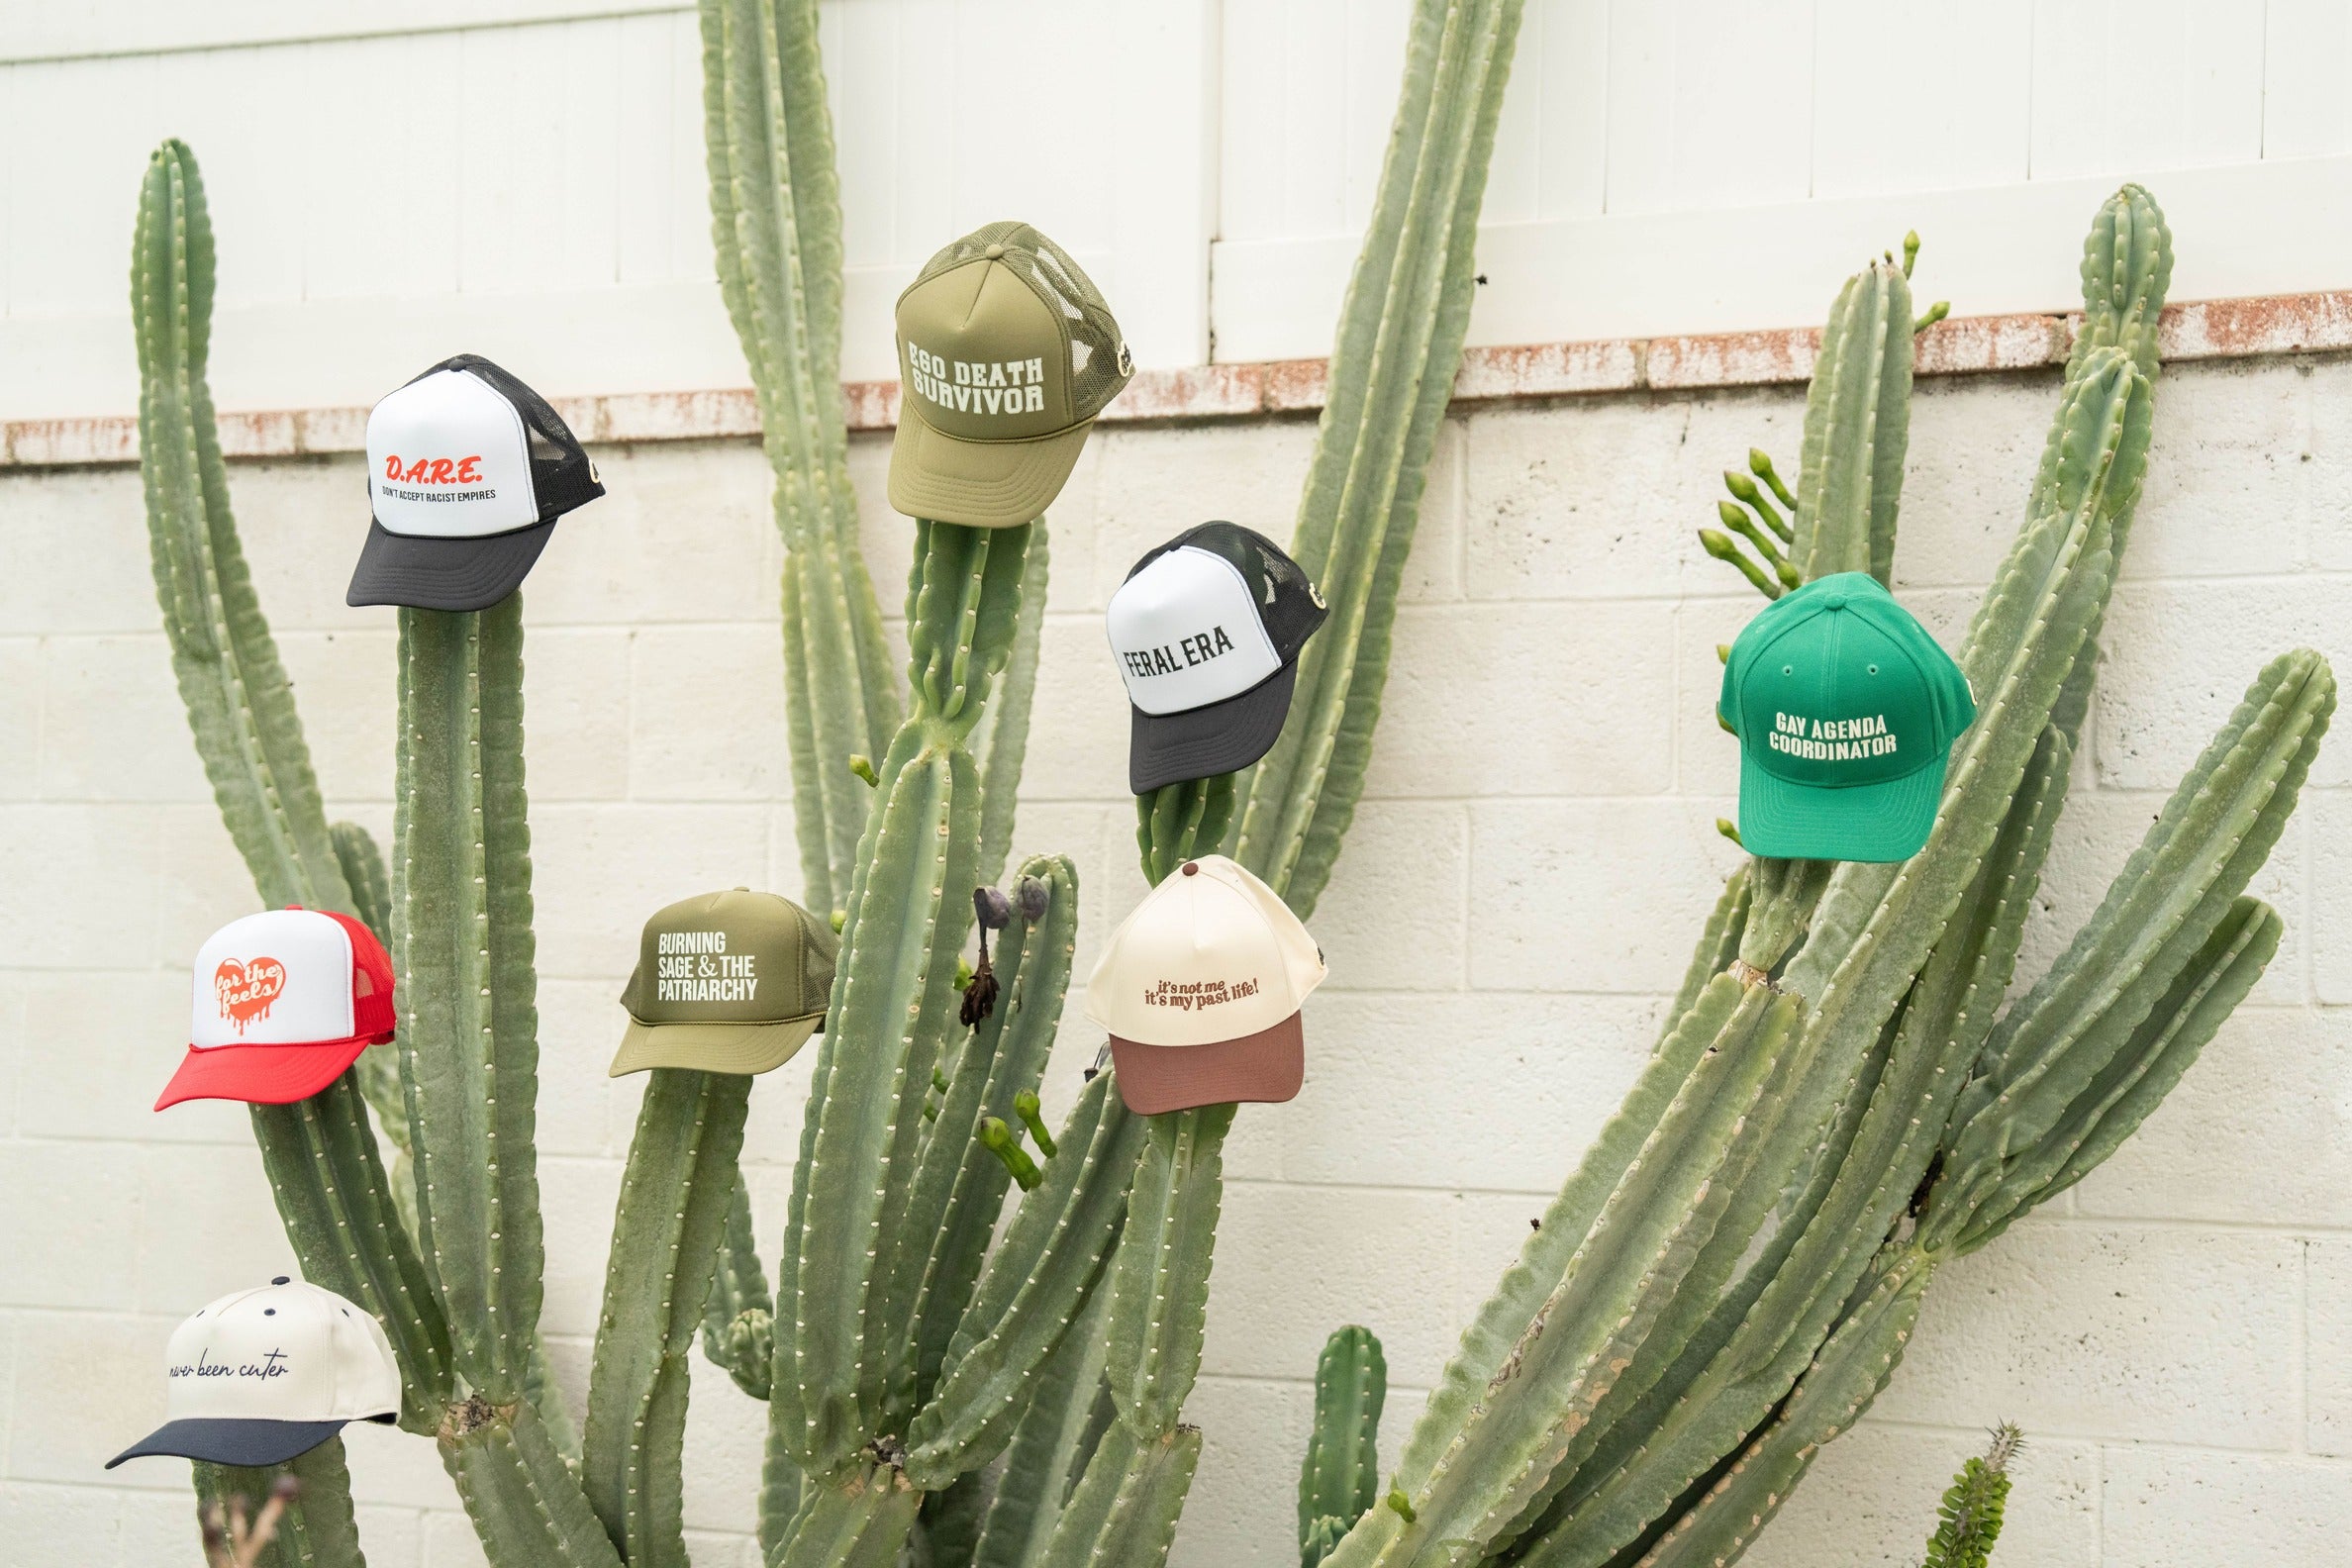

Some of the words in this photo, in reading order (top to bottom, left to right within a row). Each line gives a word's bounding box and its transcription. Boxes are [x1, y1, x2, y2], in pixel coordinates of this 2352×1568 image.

[909, 341, 946, 380] EGO
[954, 357, 1043, 387] DEATH
[912, 367, 1044, 415] SURVIVOR
[385, 454, 483, 485] D.A.R.E.
[382, 485, 399, 499] DON'T
[399, 490, 425, 502] ACCEPT
[426, 492, 455, 503] RACIST
[457, 489, 496, 502] EMPIRES
[1123, 644, 1184, 677] FERAL
[1180, 626, 1235, 667] ERA
[1776, 711, 1807, 736] GAY
[1812, 714, 1888, 740] AGENDA
[1769, 731, 1898, 761] COORDINATOR
[658, 931, 727, 955] BURNING
[216, 974, 243, 1000] for
[244, 963, 281, 984] the
[658, 956, 694, 978] SAGE
[697, 954, 719, 978] &
[719, 955, 755, 978] THE
[222, 981, 273, 1015] feels
[658, 978, 758, 1001] PATRIARCHY
[1144, 989, 1167, 1006] it's
[1169, 994, 1194, 1011] my
[1196, 989, 1231, 1011] past
[1230, 977, 1259, 1000] life!
[1158, 979, 1178, 994] it's
[1179, 981, 1203, 995] not
[1204, 980, 1225, 993] me
[197, 1347, 235, 1377] been
[239, 1346, 289, 1381] cuter
